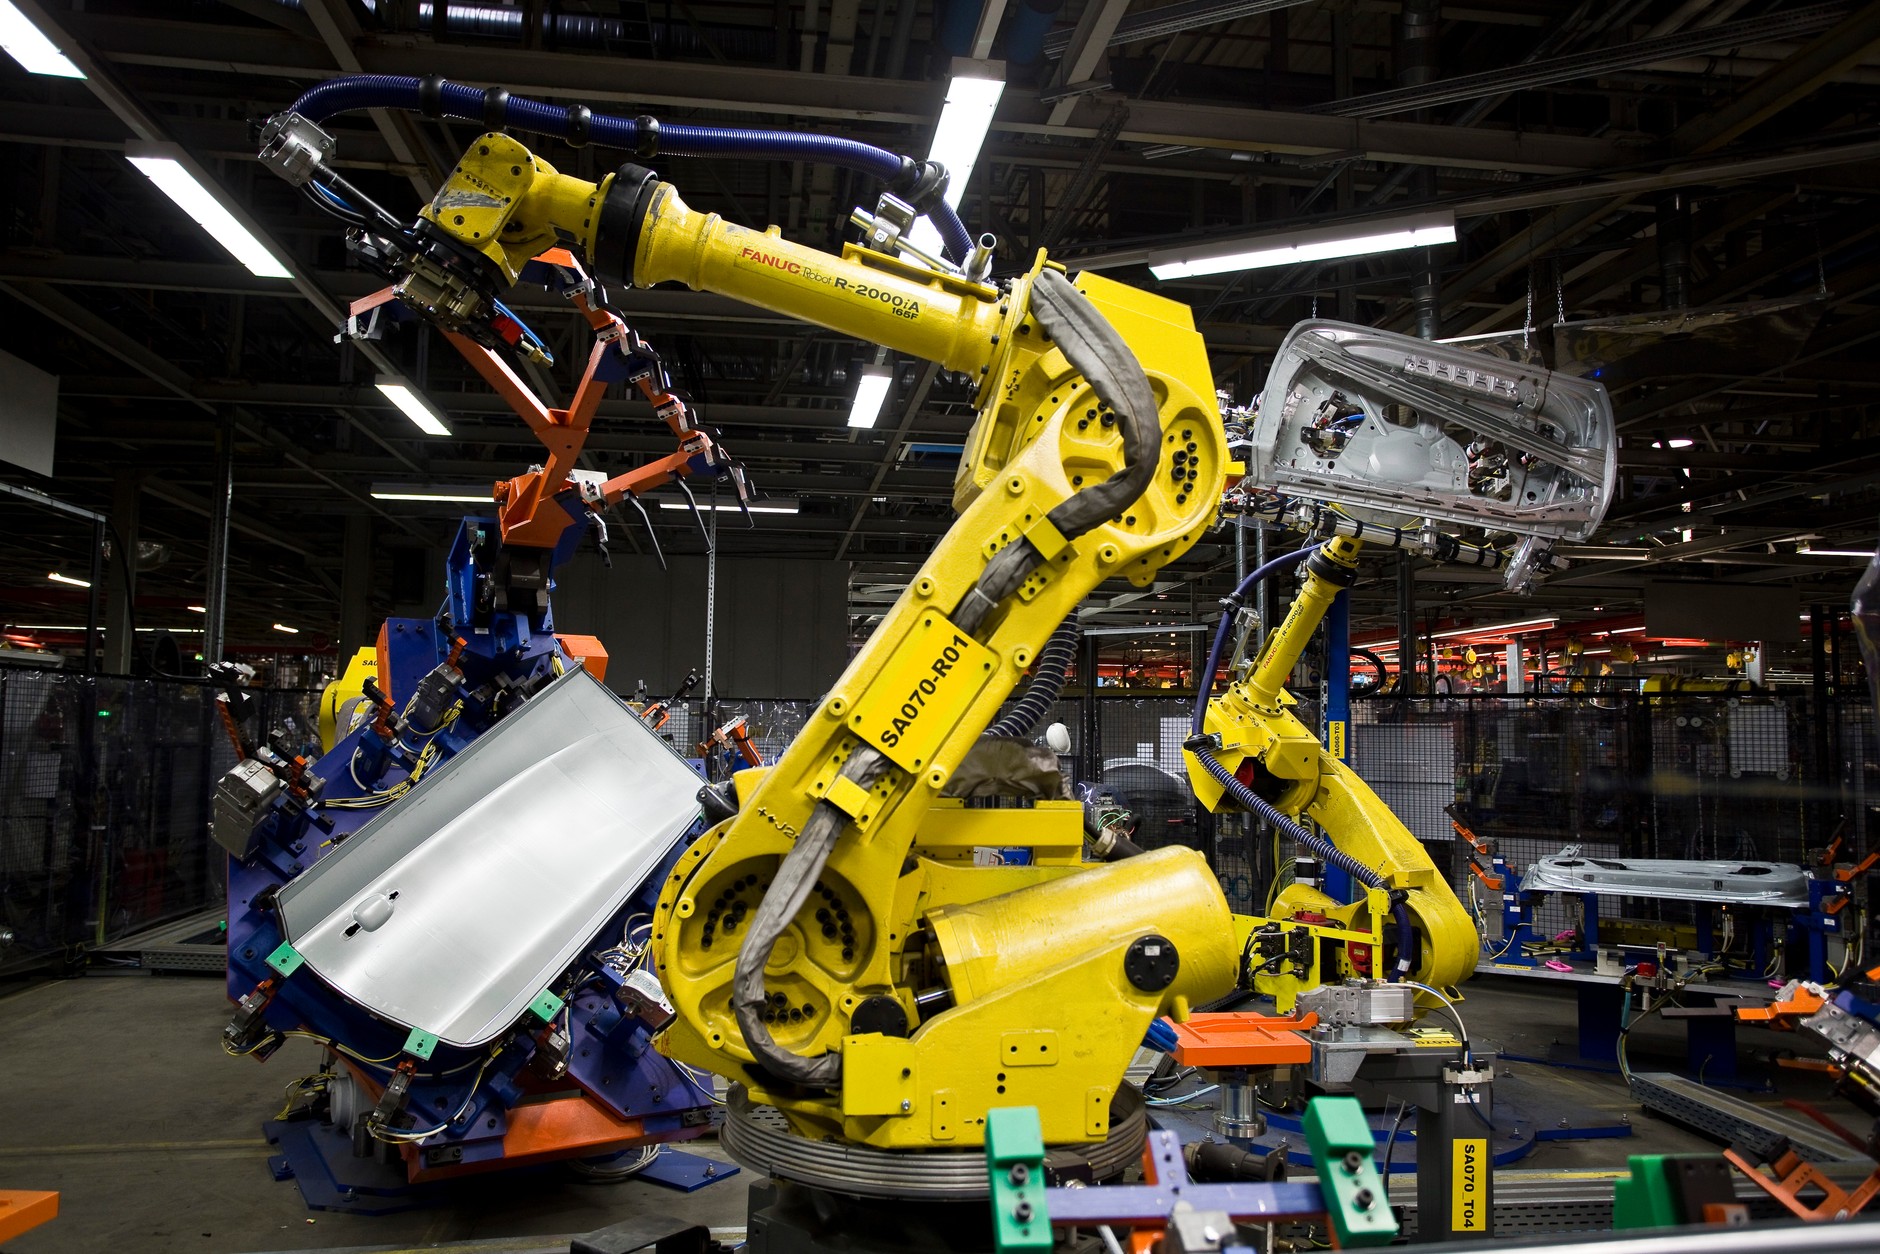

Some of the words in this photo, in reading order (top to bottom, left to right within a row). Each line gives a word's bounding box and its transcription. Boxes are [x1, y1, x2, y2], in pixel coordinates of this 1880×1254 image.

[741, 247, 801, 275] FANUC
[802, 266, 832, 285] Robot
[834, 277, 920, 313] R-2000iA
[891, 307, 918, 321] 165F
[1263, 647, 1278, 669] FANUC
[880, 634, 969, 748] SA070-R01
[774, 822, 796, 839] J2
